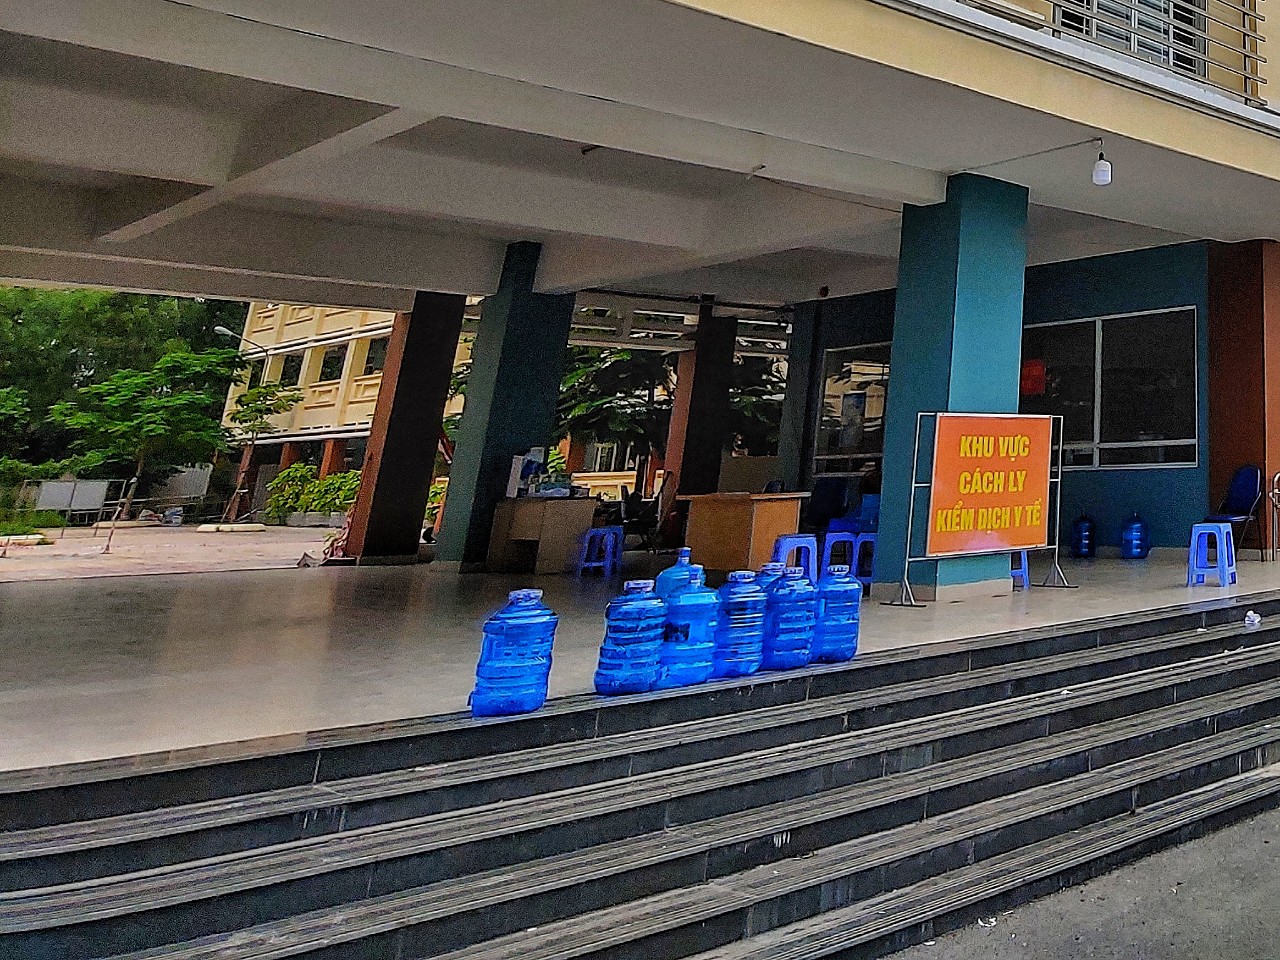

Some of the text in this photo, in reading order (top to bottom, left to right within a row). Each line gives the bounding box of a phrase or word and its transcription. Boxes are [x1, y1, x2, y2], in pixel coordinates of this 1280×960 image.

[959, 434, 1030, 461] KHU VỰC
[959, 467, 1027, 494] CÁCH LY
[936, 498, 1042, 534] KIỂM DỊCH Y TẾ
